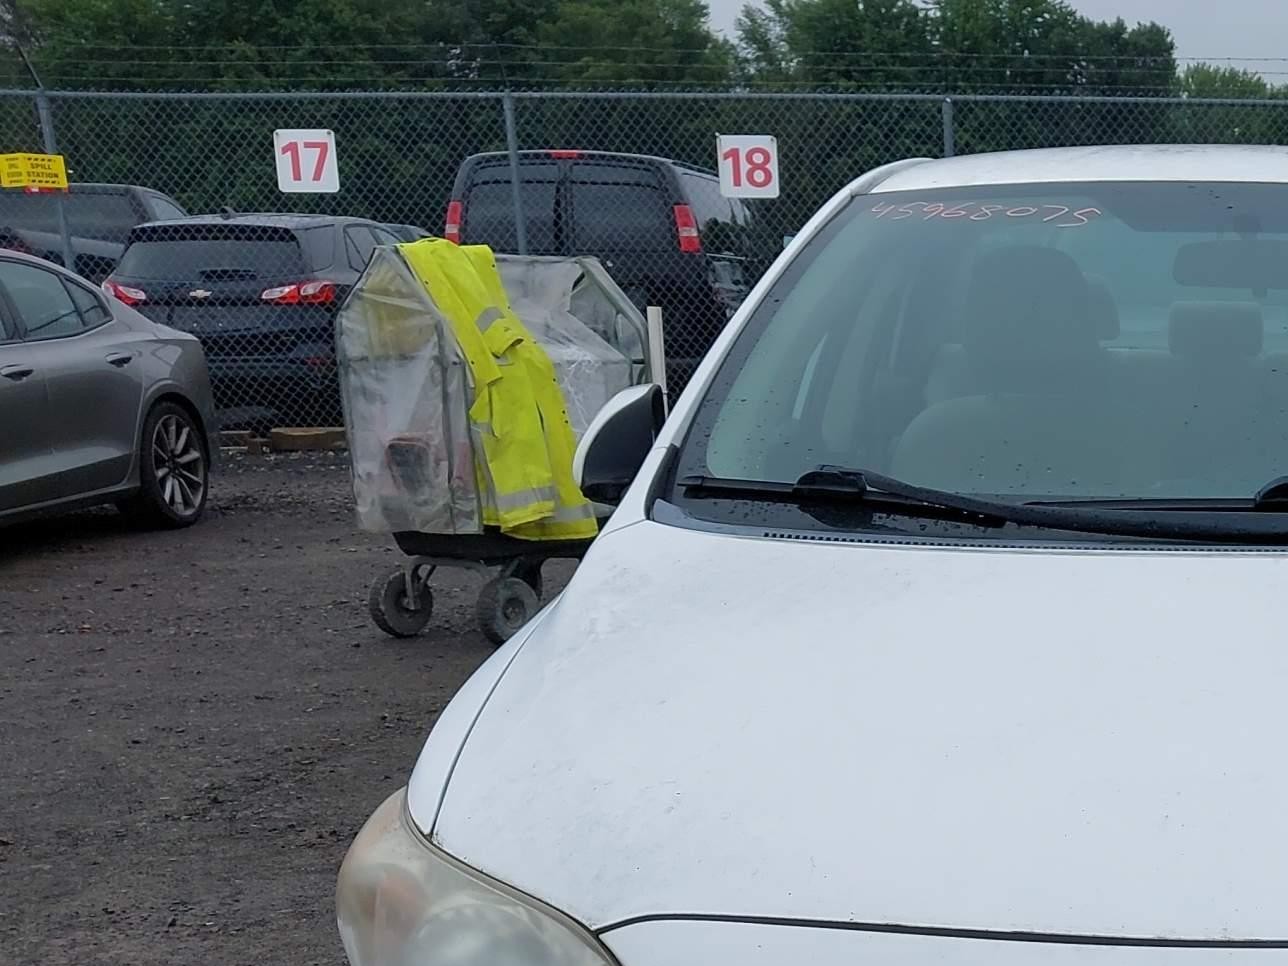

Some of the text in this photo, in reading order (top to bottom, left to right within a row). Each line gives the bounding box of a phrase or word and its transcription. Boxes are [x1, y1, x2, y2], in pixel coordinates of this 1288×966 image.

[281, 142, 328, 181] 17
[723, 147, 772, 188] 18
[871, 201, 1101, 227] 45968075
